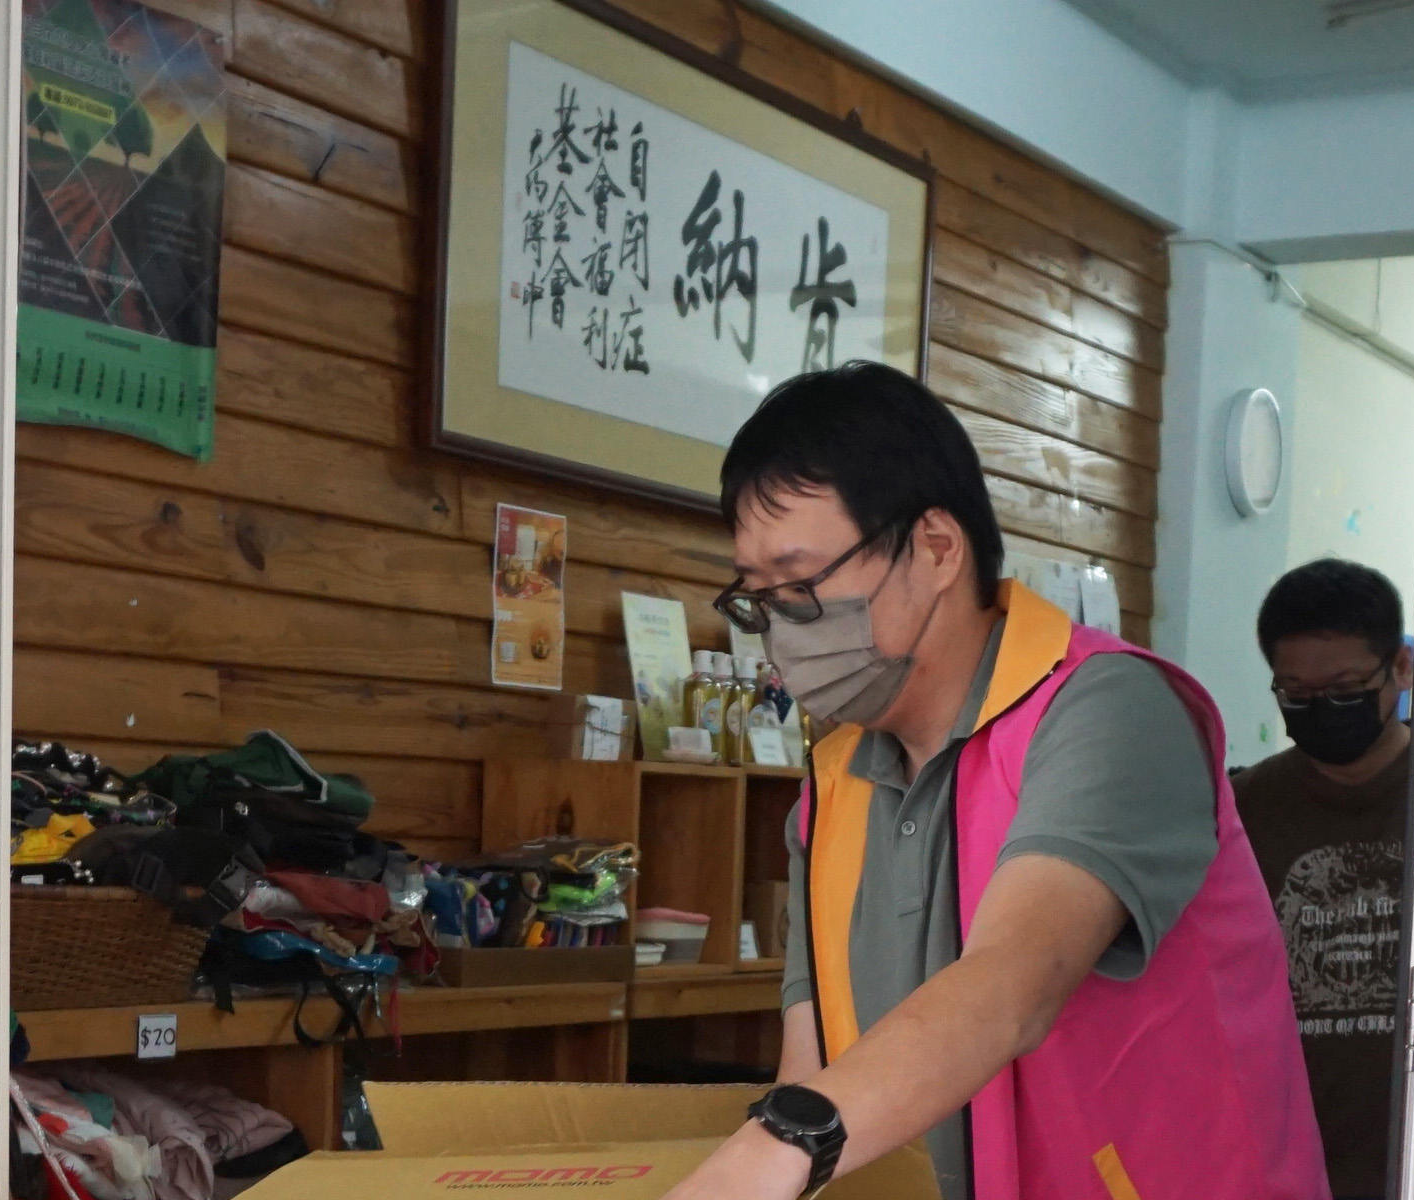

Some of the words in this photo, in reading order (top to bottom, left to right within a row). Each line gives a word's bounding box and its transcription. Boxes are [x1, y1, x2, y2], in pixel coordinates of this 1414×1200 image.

[544, 82, 593, 328] 基金會
[581, 107, 627, 371] 社會福利
[611, 121, 650, 376] 自閉症
[139, 1023, 176, 1050] $20
[433, 1164, 655, 1185] momo
[446, 1178, 615, 1190] www.momo.com.tw
